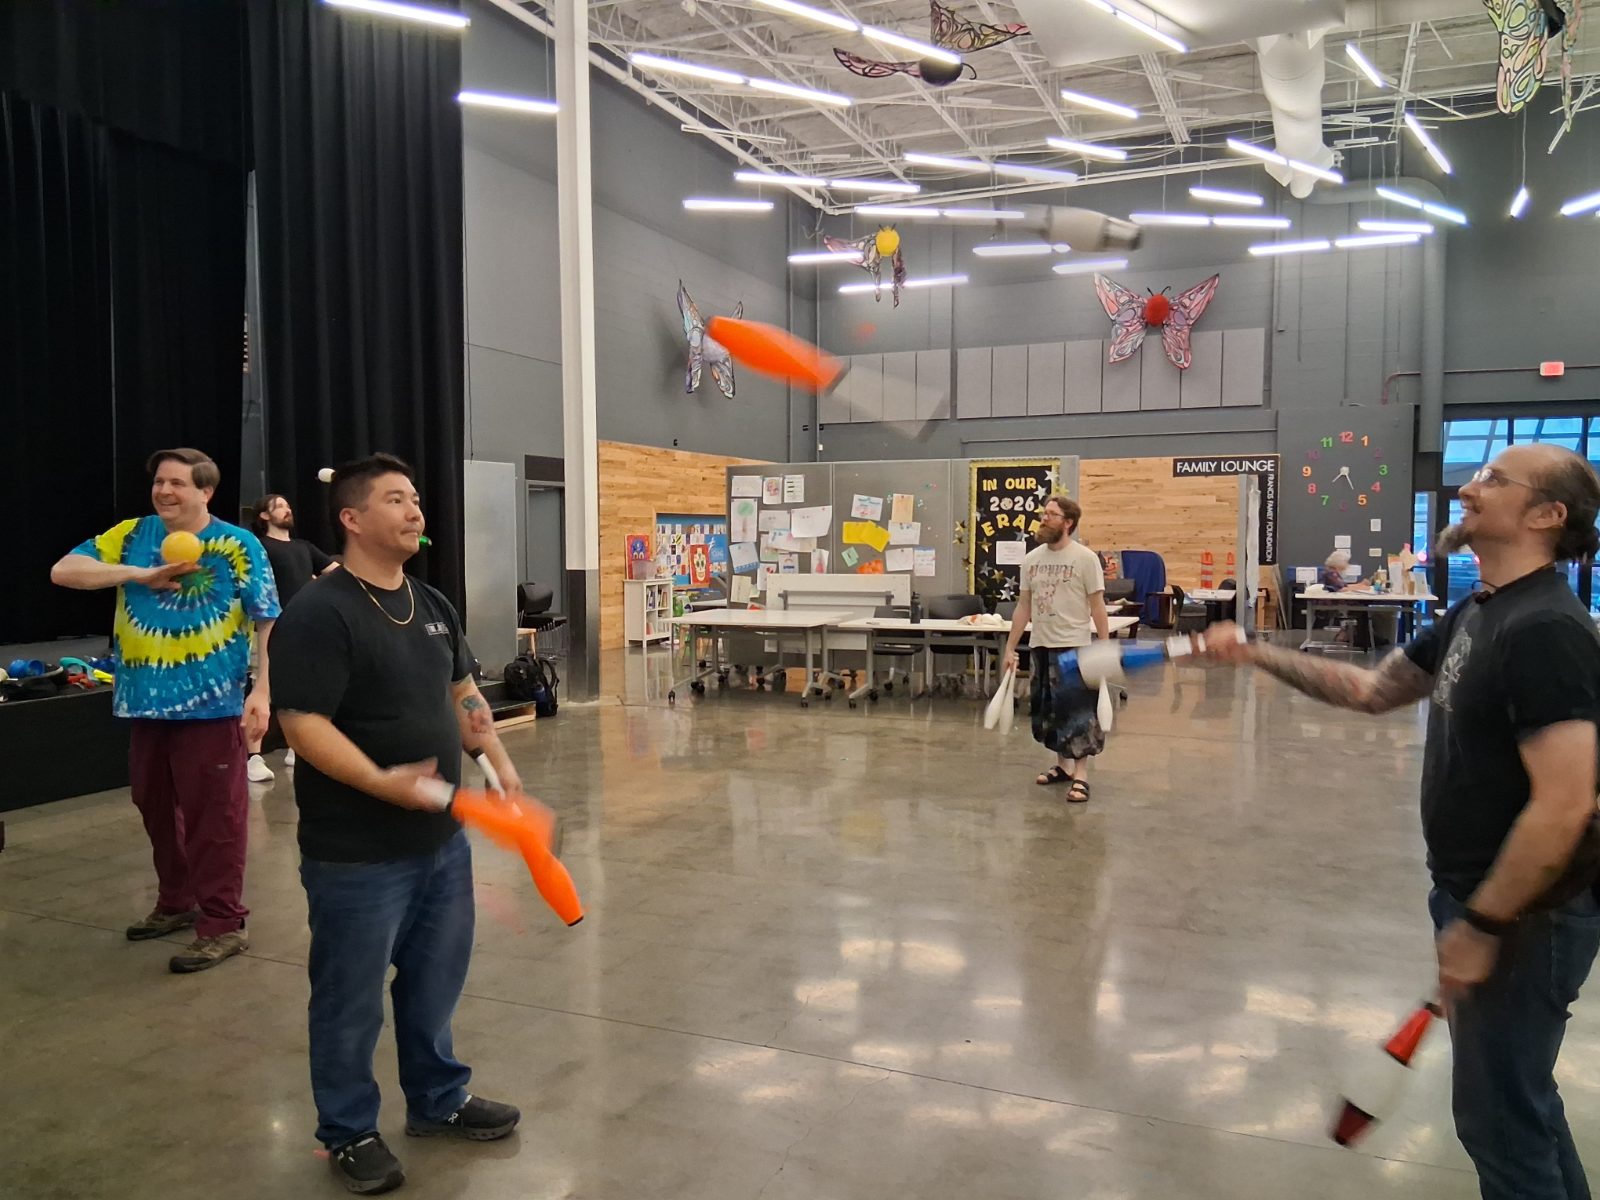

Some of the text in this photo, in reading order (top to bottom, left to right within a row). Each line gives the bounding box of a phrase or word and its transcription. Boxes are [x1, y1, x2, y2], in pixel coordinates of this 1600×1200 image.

[1339, 431, 1353, 442] 12
[1361, 435, 1369, 446] 1
[1320, 437, 1333, 448] 11
[1176, 460, 1275, 473] FAMILY LOUNGE
[1302, 466, 1311, 477] 9
[1379, 465, 1388, 475] 3
[982, 477, 1037, 491] IN OUR
[1307, 483, 1316, 494] 8
[1371, 481, 1381, 492] 4
[989, 496, 1035, 512] 2026
[1321, 495, 1329, 506] 7
[1358, 494, 1367, 505] 5
[1266, 474, 1275, 562] FRANCIS FAMILY FOUNDATION
